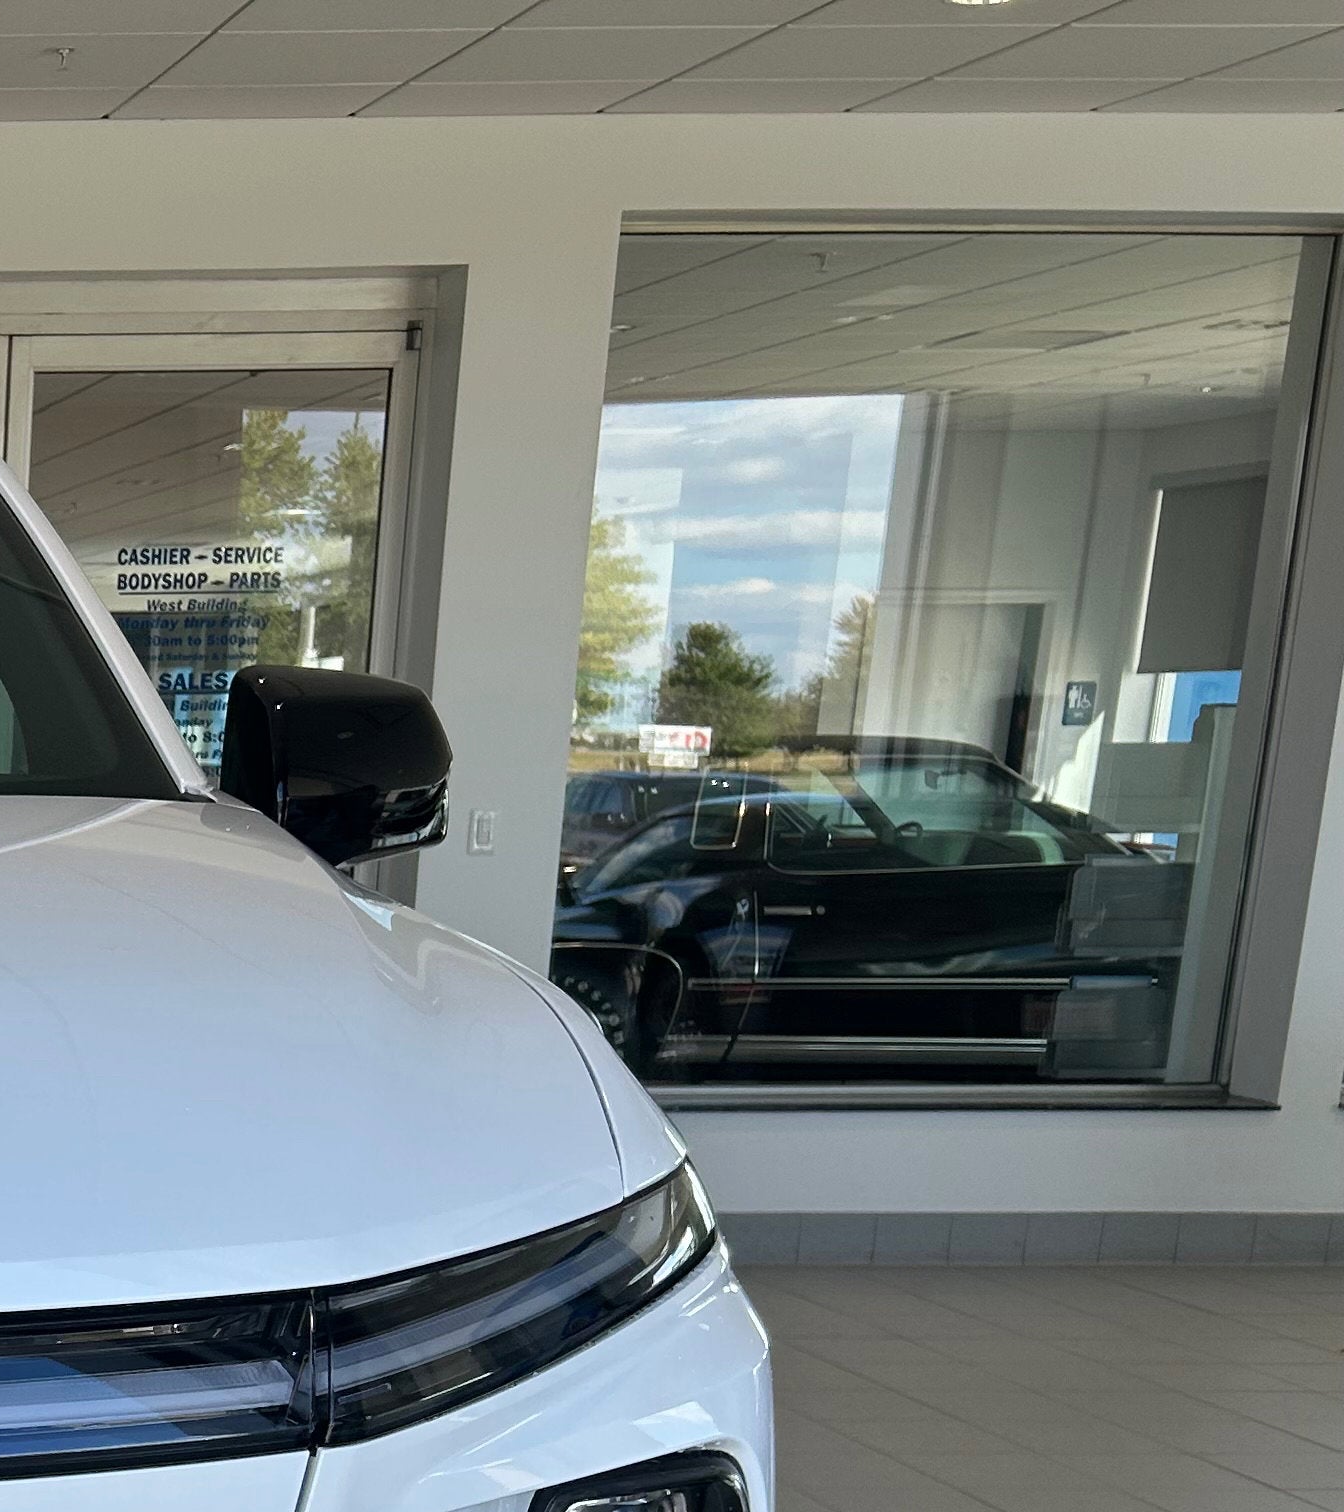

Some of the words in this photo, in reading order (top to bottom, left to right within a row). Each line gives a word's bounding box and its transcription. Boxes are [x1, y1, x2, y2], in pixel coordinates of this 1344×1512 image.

[117, 548, 191, 566] CASHIER
[212, 547, 285, 565] SERVICE
[117, 571, 209, 591] BODYSHOP
[229, 571, 283, 589] PARTS
[146, 599, 182, 613] West
[184, 616, 216, 630] thru
[220, 615, 271, 631] Friday
[188, 635, 202, 647] to
[158, 672, 229, 691] SALES
